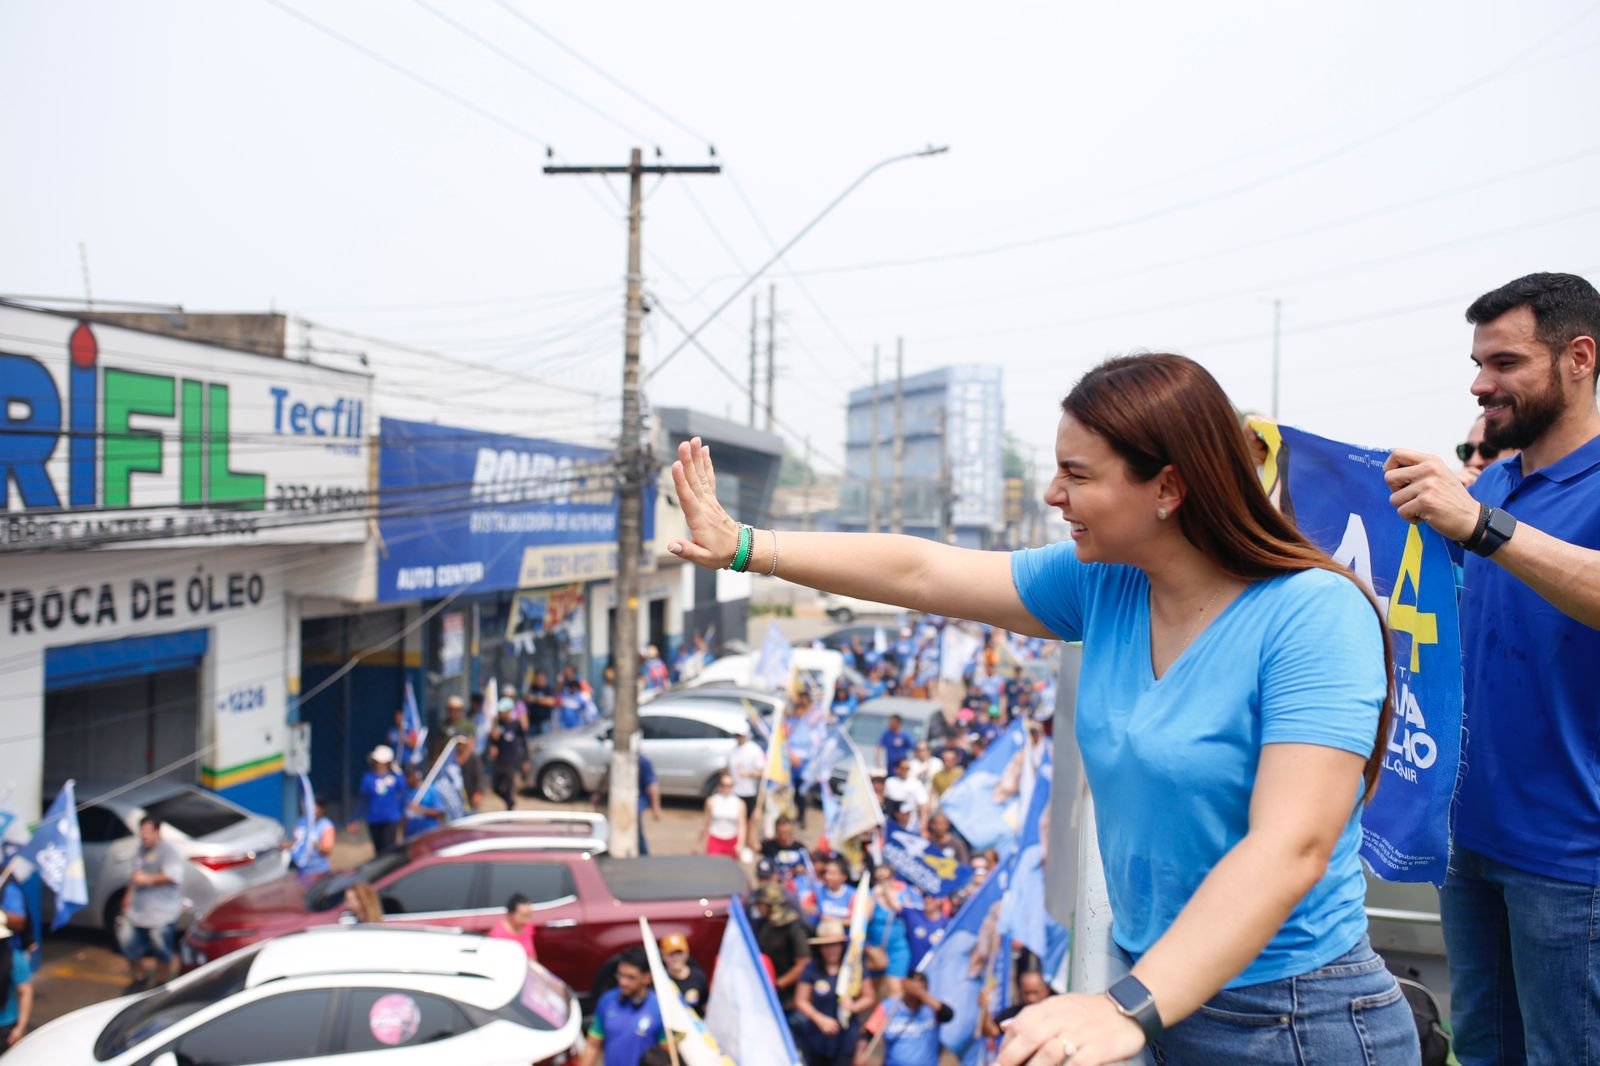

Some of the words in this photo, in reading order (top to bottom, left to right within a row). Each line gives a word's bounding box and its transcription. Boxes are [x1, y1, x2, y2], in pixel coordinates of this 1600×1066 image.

[270, 387, 364, 439] Tecfil
[0, 582, 117, 634] ROCA
[131, 579, 175, 620] DE
[187, 565, 264, 613] ÓLEO
[397, 565, 435, 590] AUTO
[436, 561, 484, 587] CENTER
